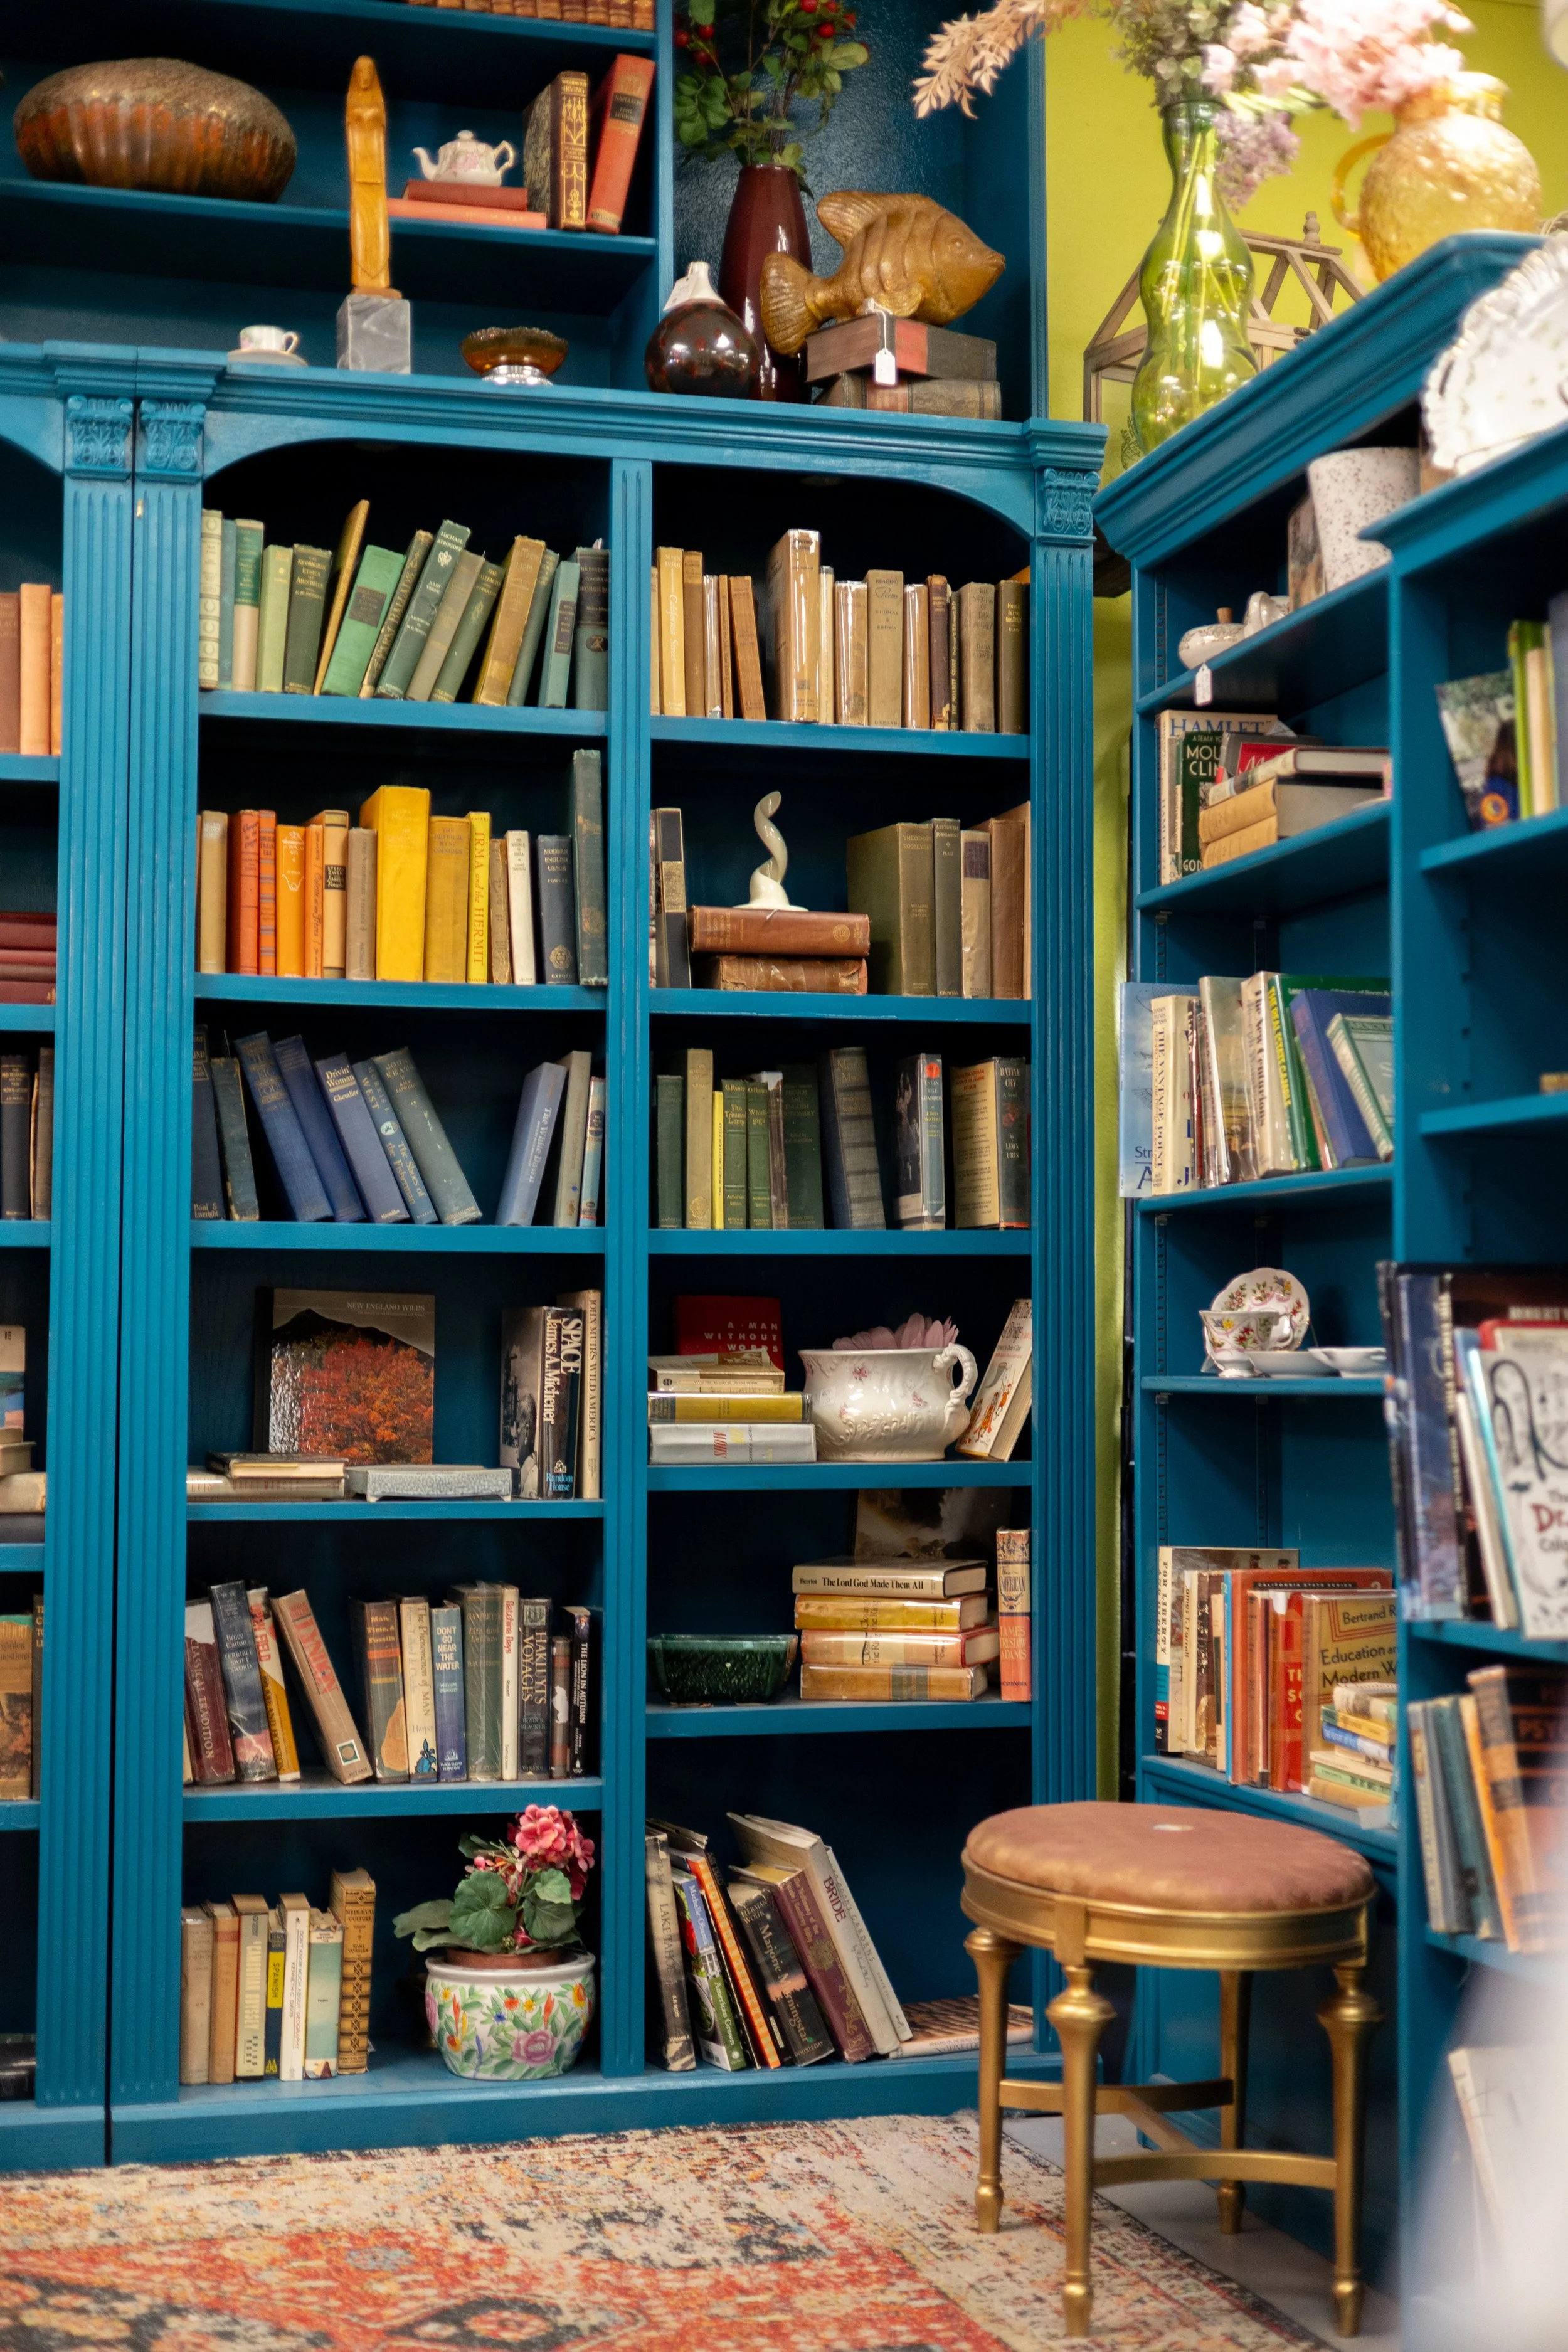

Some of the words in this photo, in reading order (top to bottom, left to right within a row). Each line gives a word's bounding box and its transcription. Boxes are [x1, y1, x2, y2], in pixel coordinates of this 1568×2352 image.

[563, 86, 585, 94] IRVING
[440, 531, 463, 544] MICHAEL
[875, 586, 898, 600] Poems
[1170, 718, 1266, 737] HAMLET
[474, 832, 485, 869] IRMA
[475, 874, 484, 889] and
[475, 890, 484, 903] the
[473, 908, 484, 966] HERMIT
[1256, 1018, 1264, 1047] New
[326, 1065, 350, 1079] Drivin'
[327, 1074, 355, 1088] Woman
[1000, 1067, 1020, 1077] BATTLE
[1005, 1078, 1016, 1088] CRY
[1256, 1048, 1266, 1128] Centurions
[333, 1089, 359, 1103] Chevalier
[362, 1077, 380, 1110] WEST
[543, 1106, 552, 1126] The
[728, 1118, 745, 1126] Lamp
[534, 1123, 548, 1155] White
[386, 1142, 396, 1157] the
[394, 1160, 415, 1205] Fisherman
[398, 1140, 408, 1159] The
[406, 1160, 420, 1187] Shoes
[417, 1187, 426, 1197] of
[529, 1155, 541, 1183] Dawn
[194, 1209, 218, 1218] Liveright
[366, 1303, 400, 1311] ENGLAND
[589, 1299, 597, 1325] JOHN
[546, 1315, 559, 1353] James
[704, 1332, 777, 1341] WITHOUT
[560, 1317, 583, 1375] SPACE
[727, 1344, 778, 1352] WORDS
[544, 1371, 560, 1424] Michener
[588, 1391, 596, 1441] AMERICA
[713, 1430, 728, 1458] SHOW
[546, 1473, 573, 1483] Random
[549, 1481, 570, 1491] House
[822, 1577, 836, 1587] The
[837, 1578, 852, 1587] Lord
[854, 1579, 869, 1587] God
[870, 1579, 889, 1588] Made
[890, 1579, 911, 1589] Them
[912, 1581, 924, 1589] All
[999, 1576, 1025, 1591] AMERICAN
[418, 1605, 427, 1624] The
[1342, 1606, 1386, 1624] Bertrand
[226, 1633, 244, 1641] Bruce
[437, 1626, 457, 1635] DON'T
[1000, 1626, 1025, 1636] JAMES
[225, 1640, 247, 1650] Catton
[256, 1630, 271, 1661] FIELD
[437, 1644, 457, 1653] NEAR
[442, 1636, 453, 1644] GO
[504, 1636, 514, 1654] Days
[224, 1649, 252, 1660] TERRIBLE
[418, 1625, 429, 1677] Phenomenon
[440, 1653, 455, 1661] THE
[1001, 1650, 1027, 1660] ADAMS
[1320, 1646, 1386, 1665] Education
[230, 1656, 251, 1666] SWIFT
[230, 1663, 252, 1673] SWORD
[435, 1661, 460, 1671] WATER
[522, 1636, 534, 1702] VOYAGES
[534, 1631, 547, 1705] HAKLUYT'S
[422, 1679, 432, 1687] of
[580, 1680, 587, 1688] IN
[1323, 1669, 1380, 1688] Modern
[190, 1638, 205, 1695] CLASSICAL
[199, 1697, 215, 1759] TRADITION
[421, 1691, 431, 1717] MAN
[411, 1724, 434, 1734] Harper
[741, 1899, 768, 1917] HERMAN
[823, 1875, 847, 1923] BRIDE
[660, 1903, 672, 1934] LAKE
[689, 1885, 703, 1918] Michelle
[697, 1918, 709, 1946] Obama
[743, 1910, 766, 1924] WOUK
[850, 1911, 876, 1963] GARDENS
[664, 1938, 677, 1974] TAHOE
[759, 1923, 782, 1973] Marjorie
[272, 1963, 280, 1999] SPANISH
[714, 1981, 727, 2018] American
[723, 2018, 735, 2045] Grown
